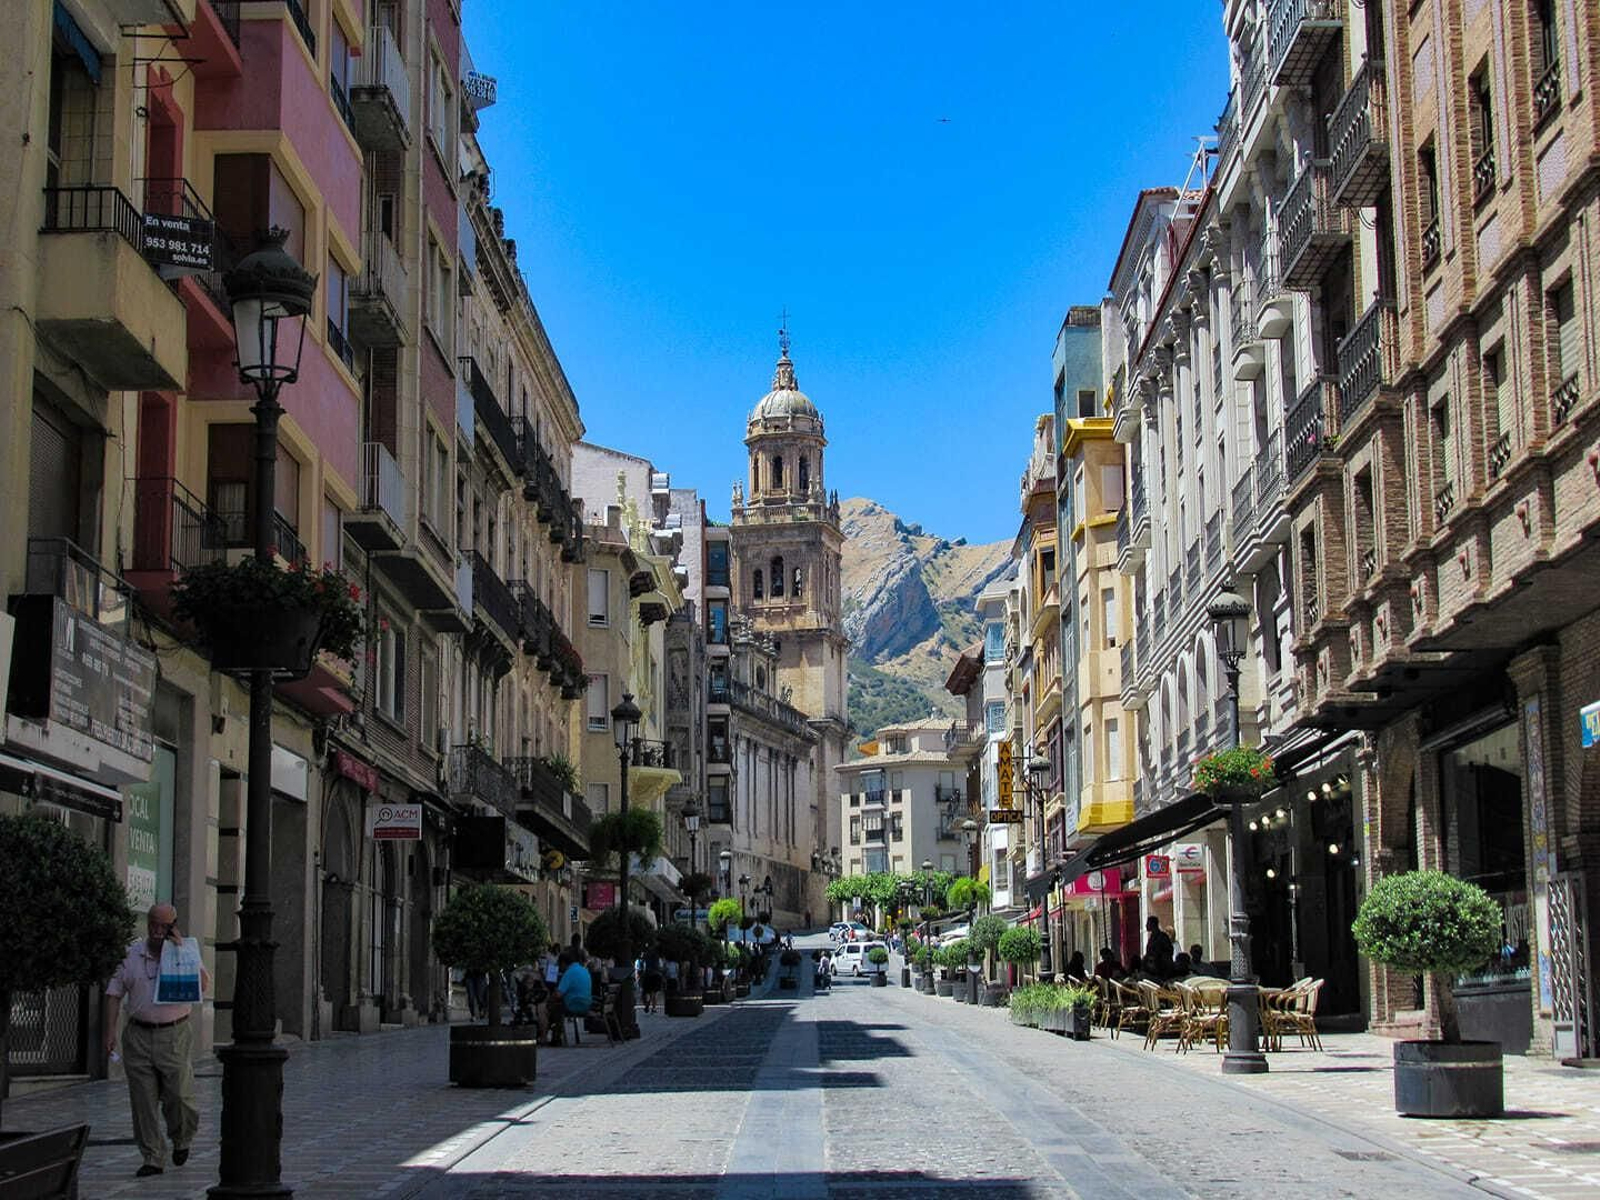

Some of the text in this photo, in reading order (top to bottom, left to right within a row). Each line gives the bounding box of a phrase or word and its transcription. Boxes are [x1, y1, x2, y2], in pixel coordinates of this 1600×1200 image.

[145, 216, 191, 231] En venta
[145, 237, 210, 255] 953 981 714
[1000, 744, 1011, 806] AMATE
[393, 808, 418, 820] ACM
[990, 811, 1023, 822] OPTICA
[129, 827, 155, 854] VENTA
